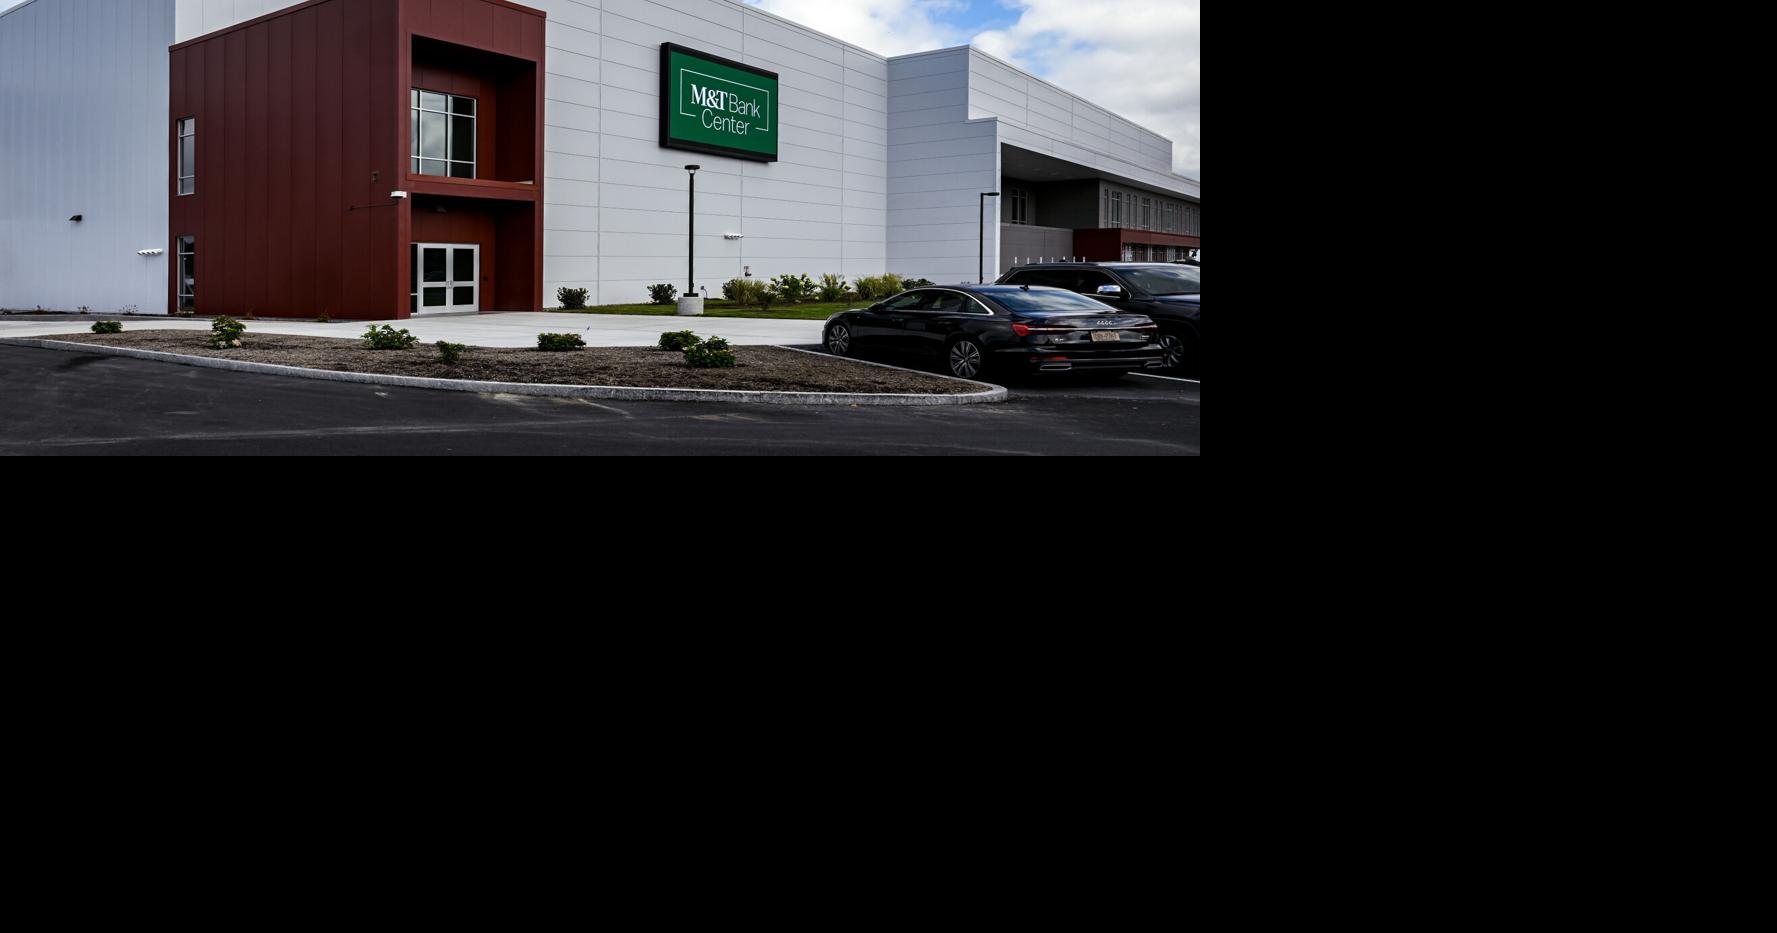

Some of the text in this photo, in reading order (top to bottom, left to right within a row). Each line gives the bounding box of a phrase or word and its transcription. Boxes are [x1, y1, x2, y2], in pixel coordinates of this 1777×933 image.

[691, 84, 760, 118] M&T Bank
[702, 108, 750, 135] Center
